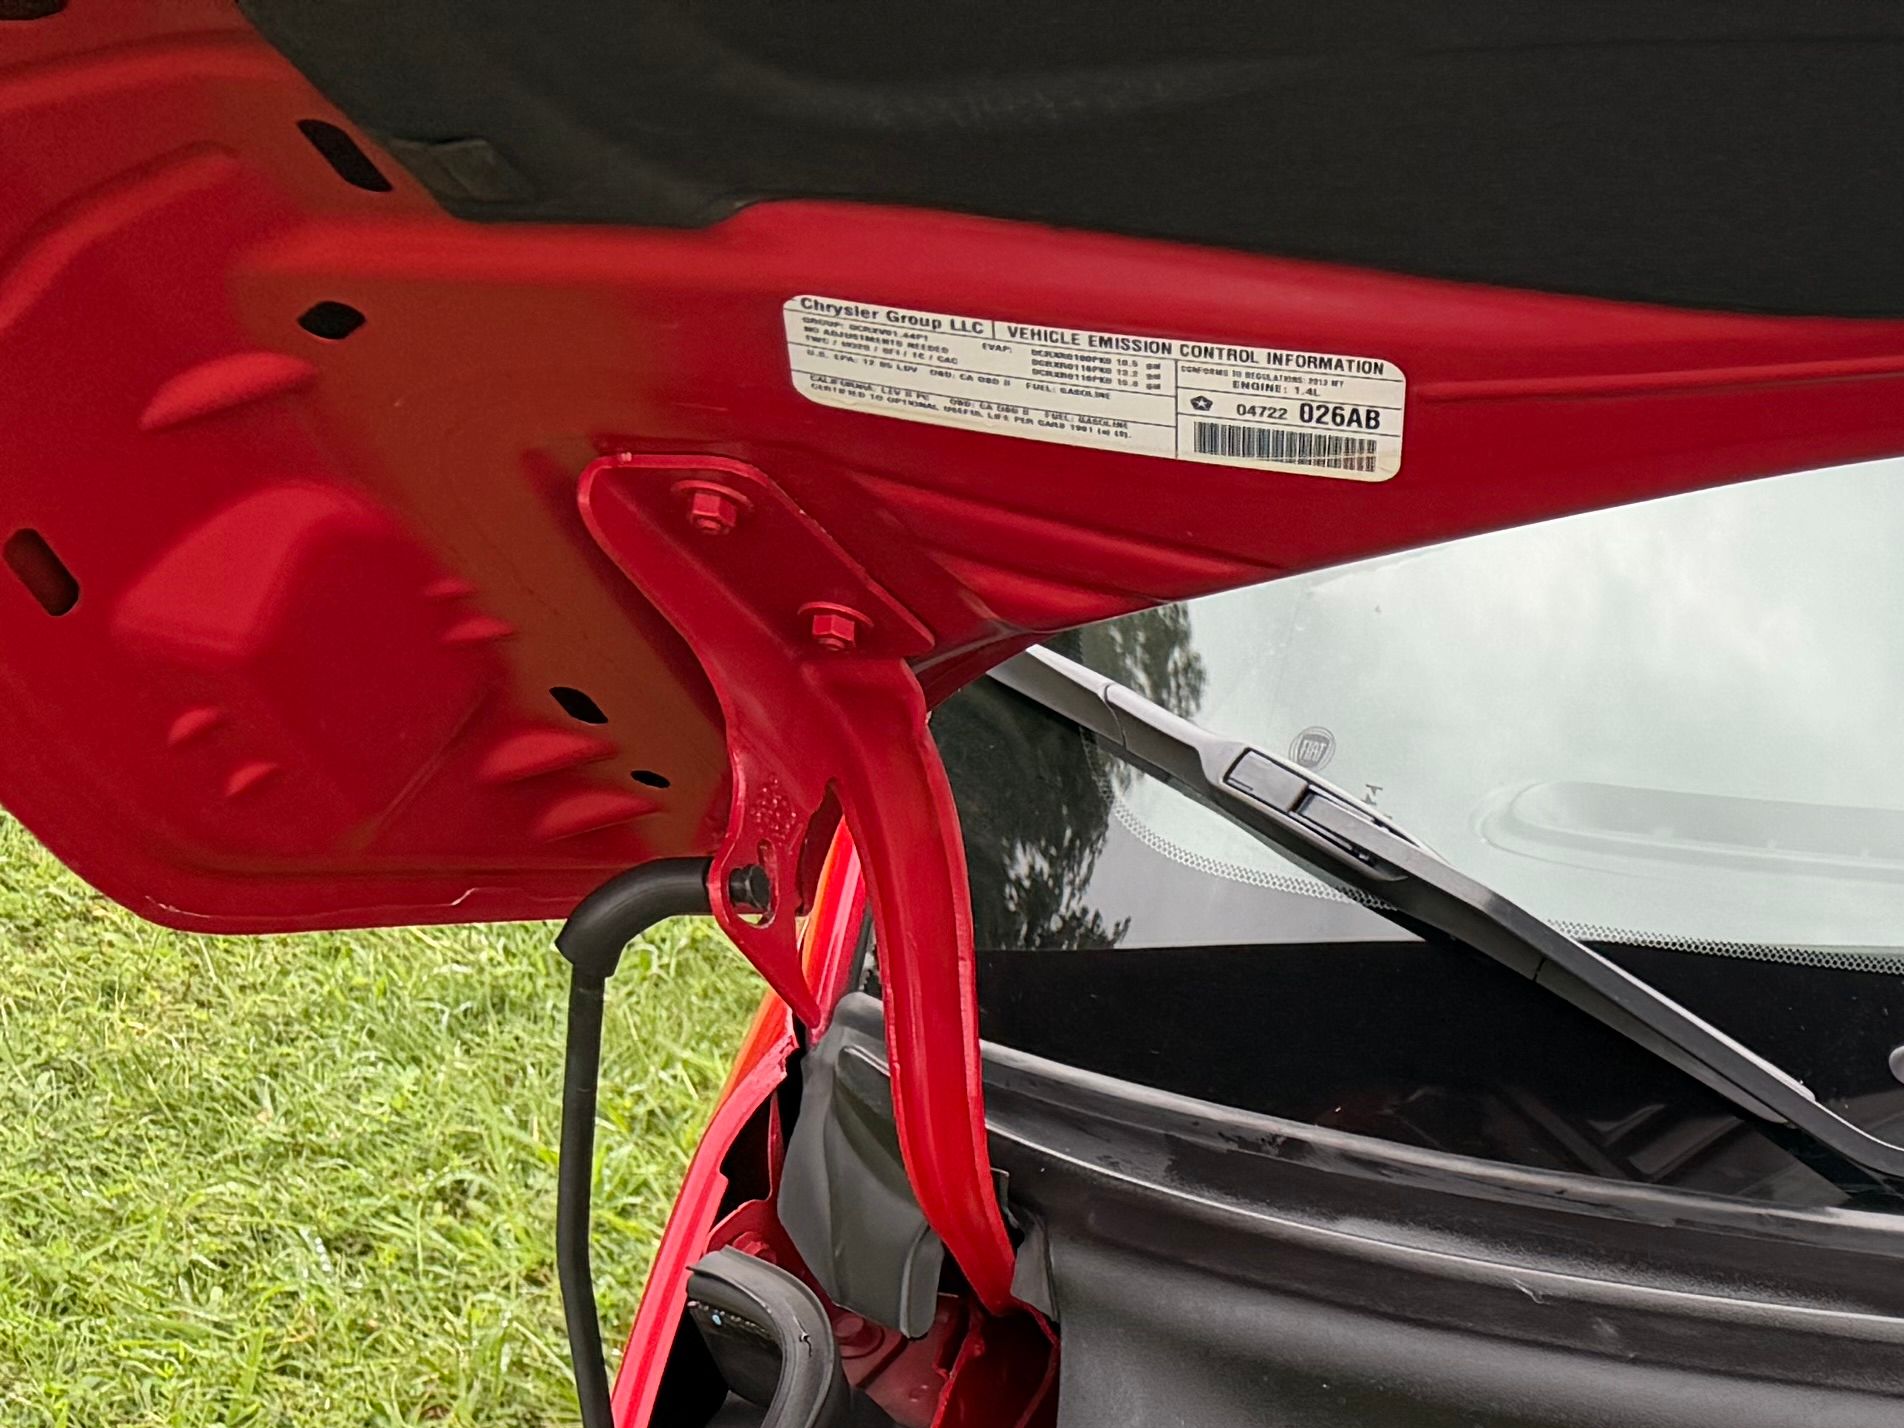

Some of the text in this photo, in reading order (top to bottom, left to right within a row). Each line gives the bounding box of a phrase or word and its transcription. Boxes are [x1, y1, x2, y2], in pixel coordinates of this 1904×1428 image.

[800, 297, 879, 319] Chrysler
[886, 310, 942, 330] Group
[950, 318, 983, 334] LLC
[1007, 325, 1081, 346] VEHICLE
[1088, 335, 1172, 355] EMISSION
[1180, 344, 1258, 364] CONTROL
[1267, 351, 1384, 375] INFORMATION
[1232, 380, 1321, 397] ENGINE: 1.4L
[1236, 402, 1380, 430] 04722 026AB
